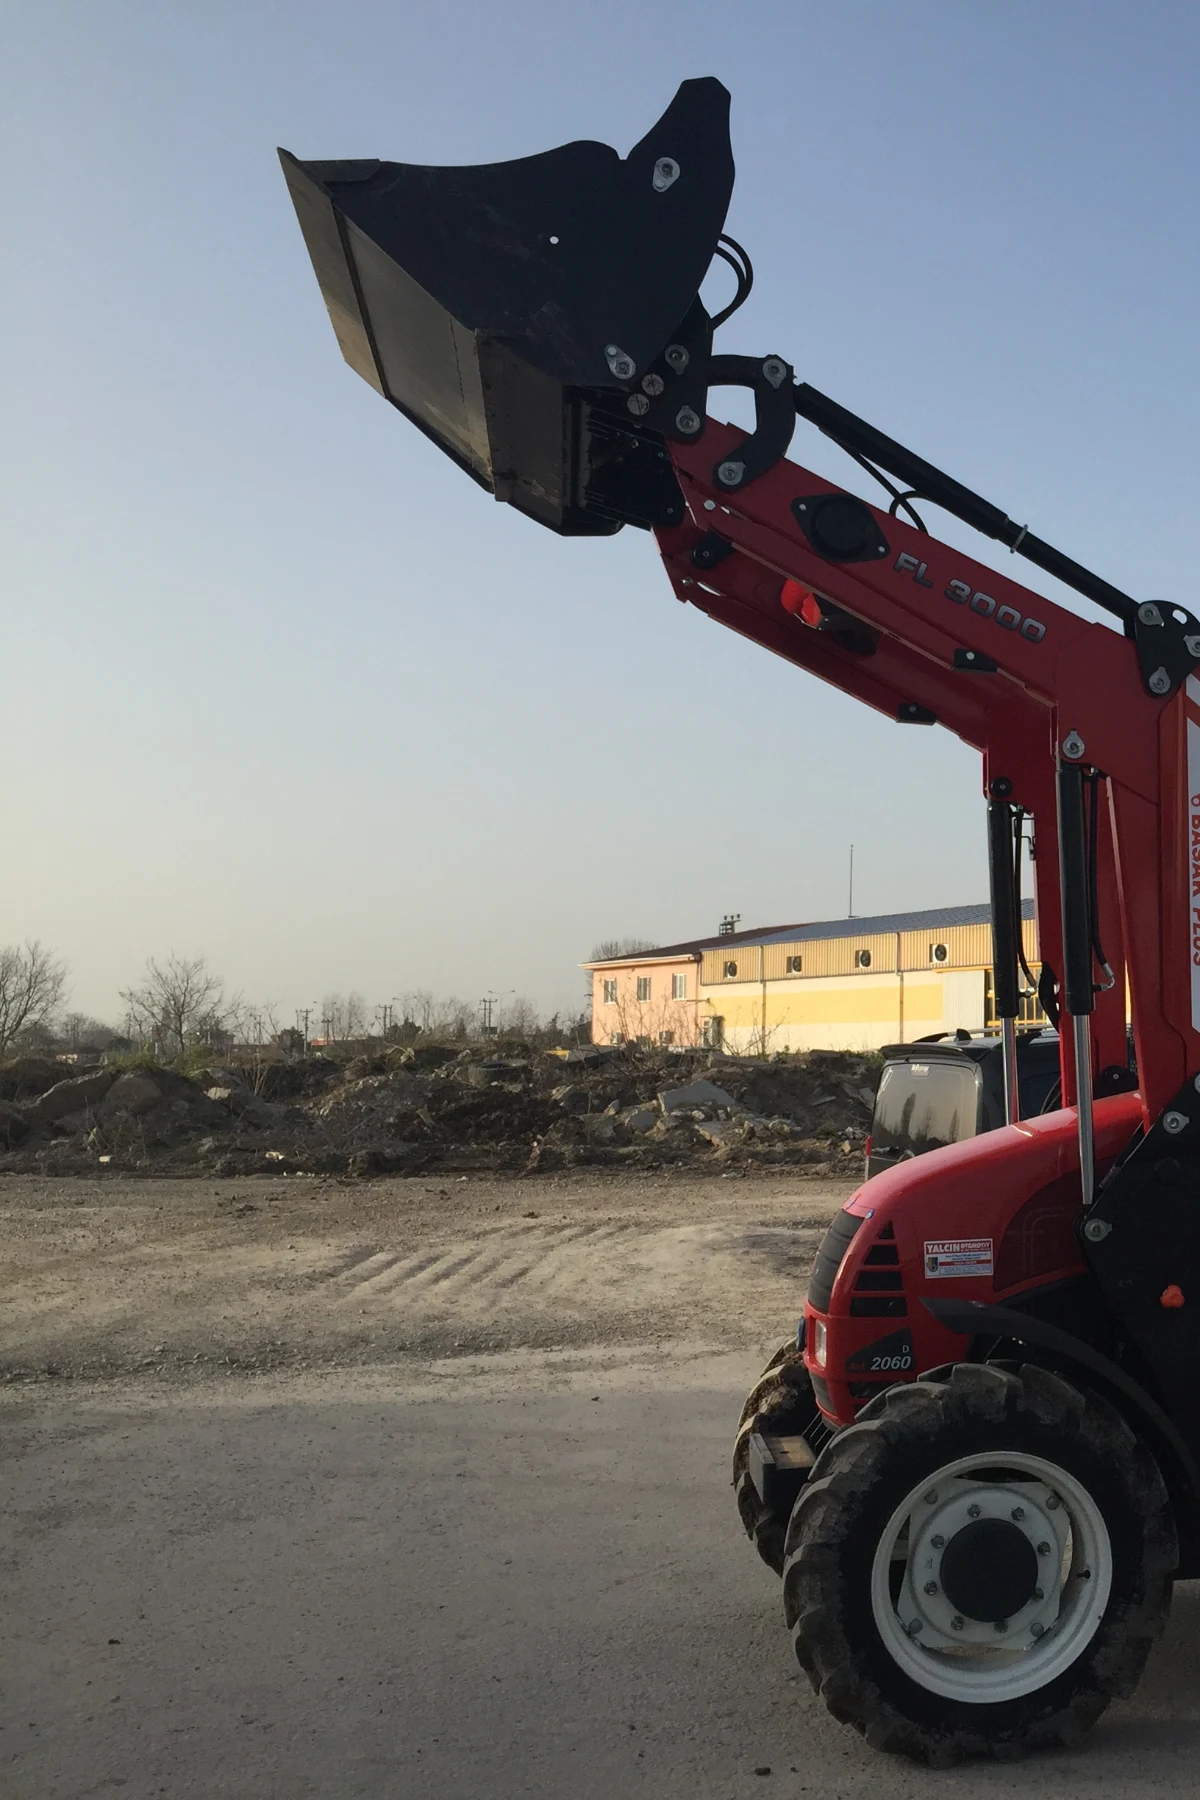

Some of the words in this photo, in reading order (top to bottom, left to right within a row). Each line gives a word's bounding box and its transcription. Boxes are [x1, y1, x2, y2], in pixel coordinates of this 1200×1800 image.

[893, 552, 933, 588] FL
[944, 579, 1047, 644] 3000
[902, 1344, 909, 1353] D
[870, 1356, 911, 1370] 2060
